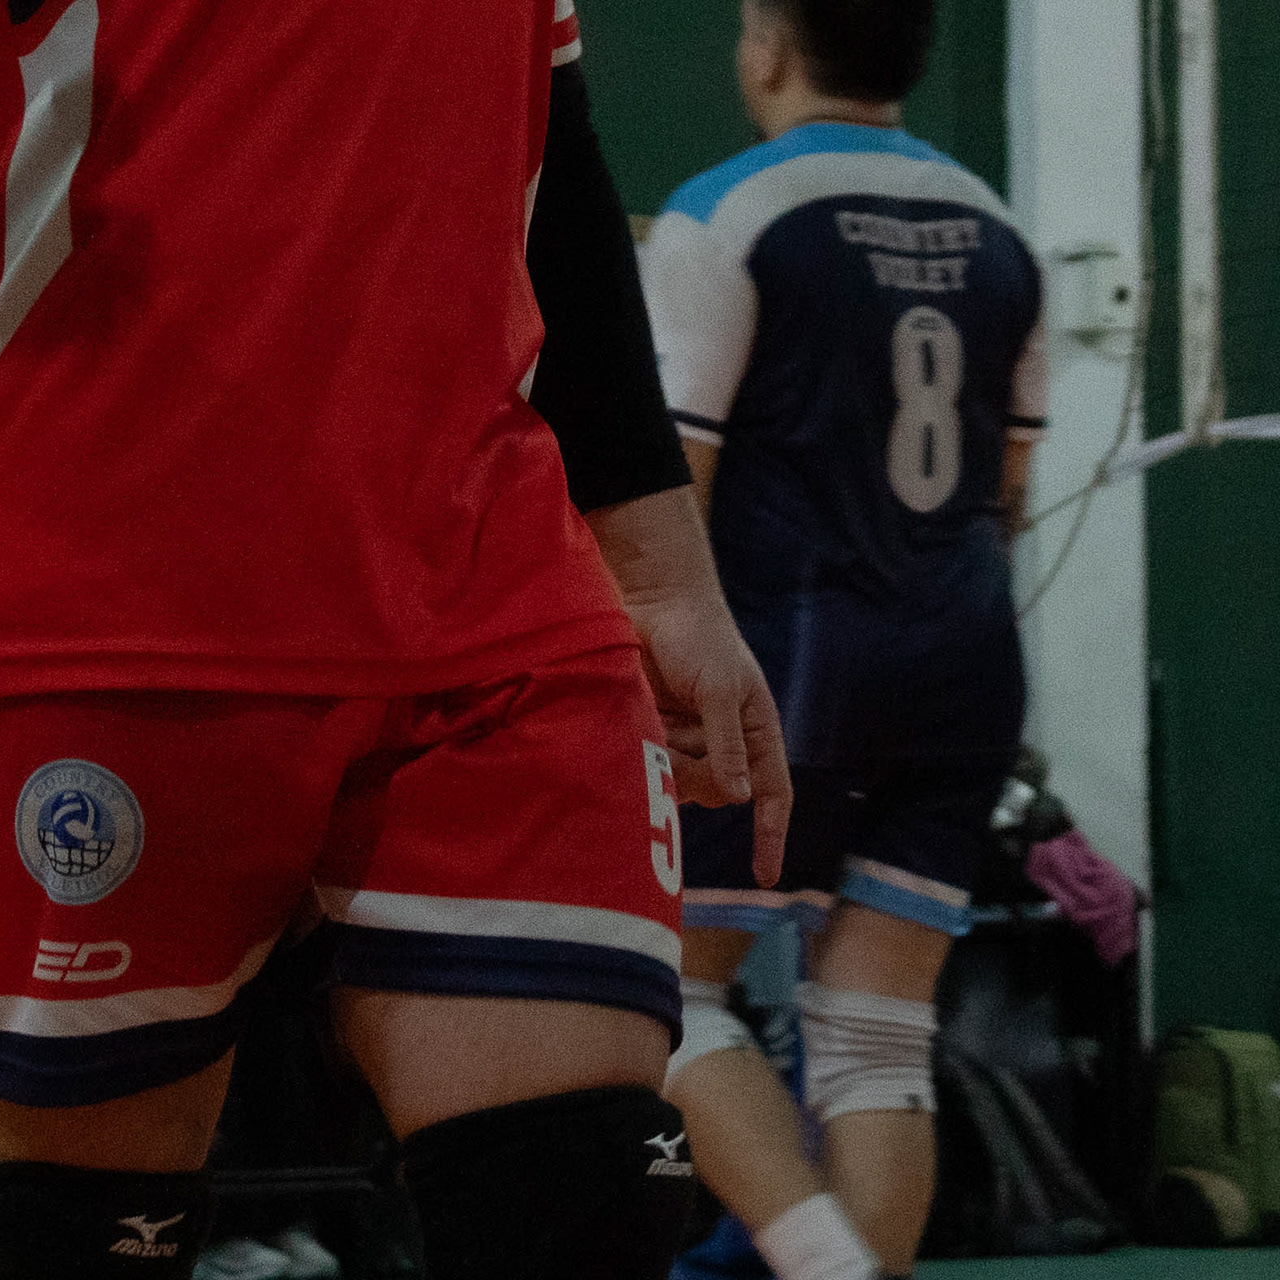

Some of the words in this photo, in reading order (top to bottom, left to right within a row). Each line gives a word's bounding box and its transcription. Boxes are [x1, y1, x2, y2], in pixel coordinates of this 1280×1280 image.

[887, 304, 964, 514] 8
[642, 739, 682, 896] 5
[33, 940, 132, 983] ED
